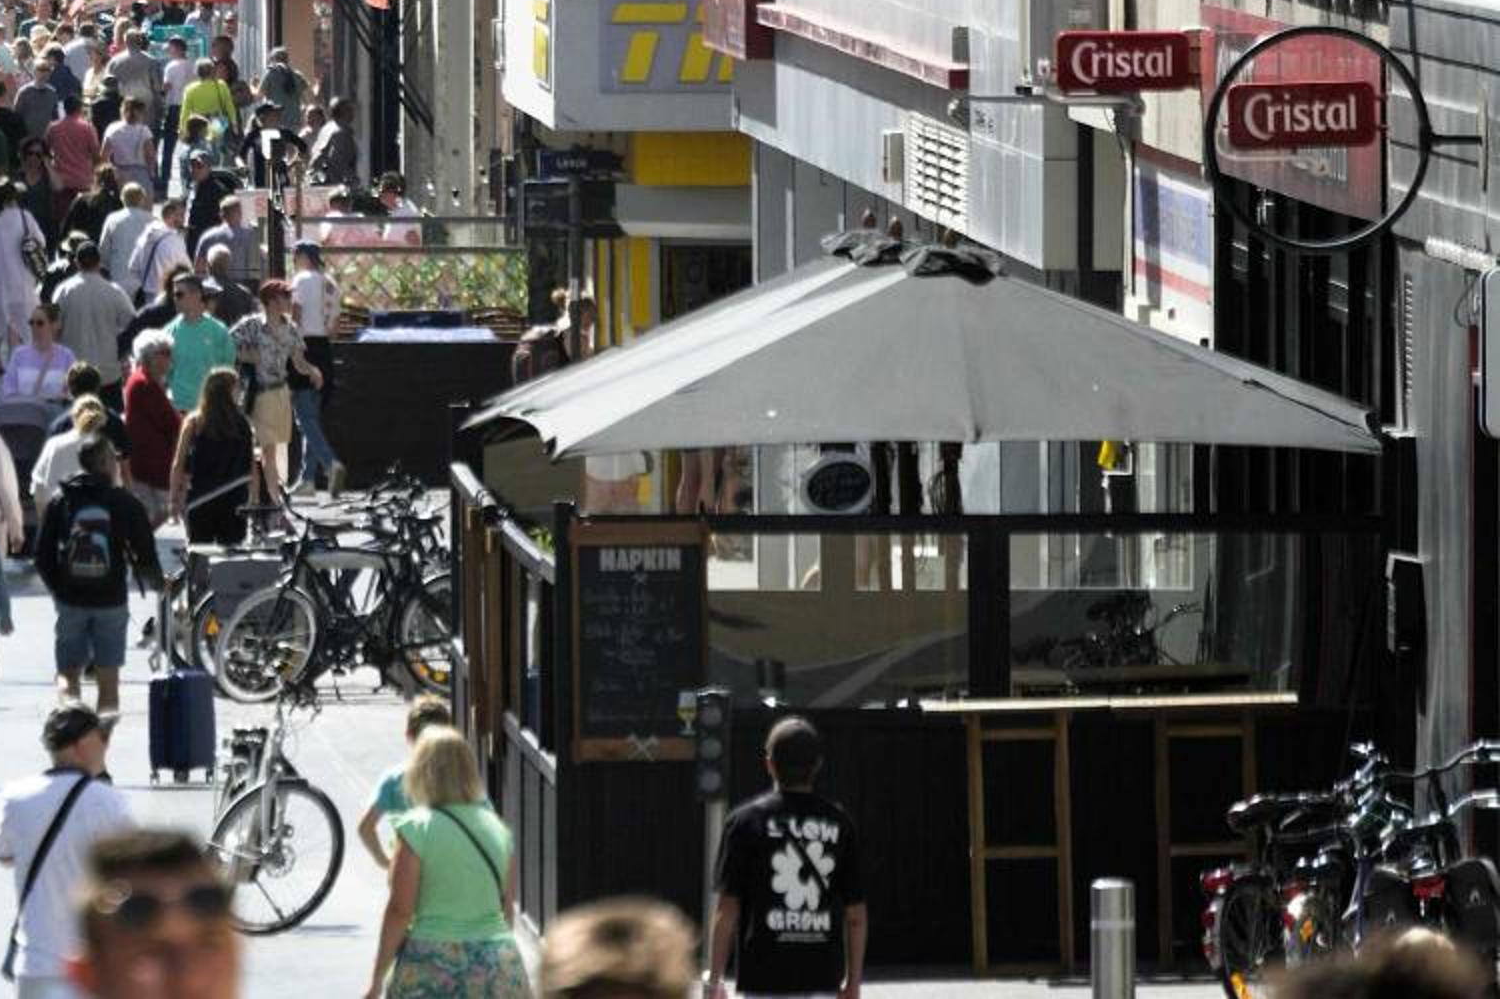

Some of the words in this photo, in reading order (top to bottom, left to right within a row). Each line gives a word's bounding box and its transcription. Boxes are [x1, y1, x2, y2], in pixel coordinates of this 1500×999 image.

[1071, 41, 1173, 85] Cristal
[1243, 93, 1358, 142] Cristal
[600, 548, 681, 571] NAPKIN
